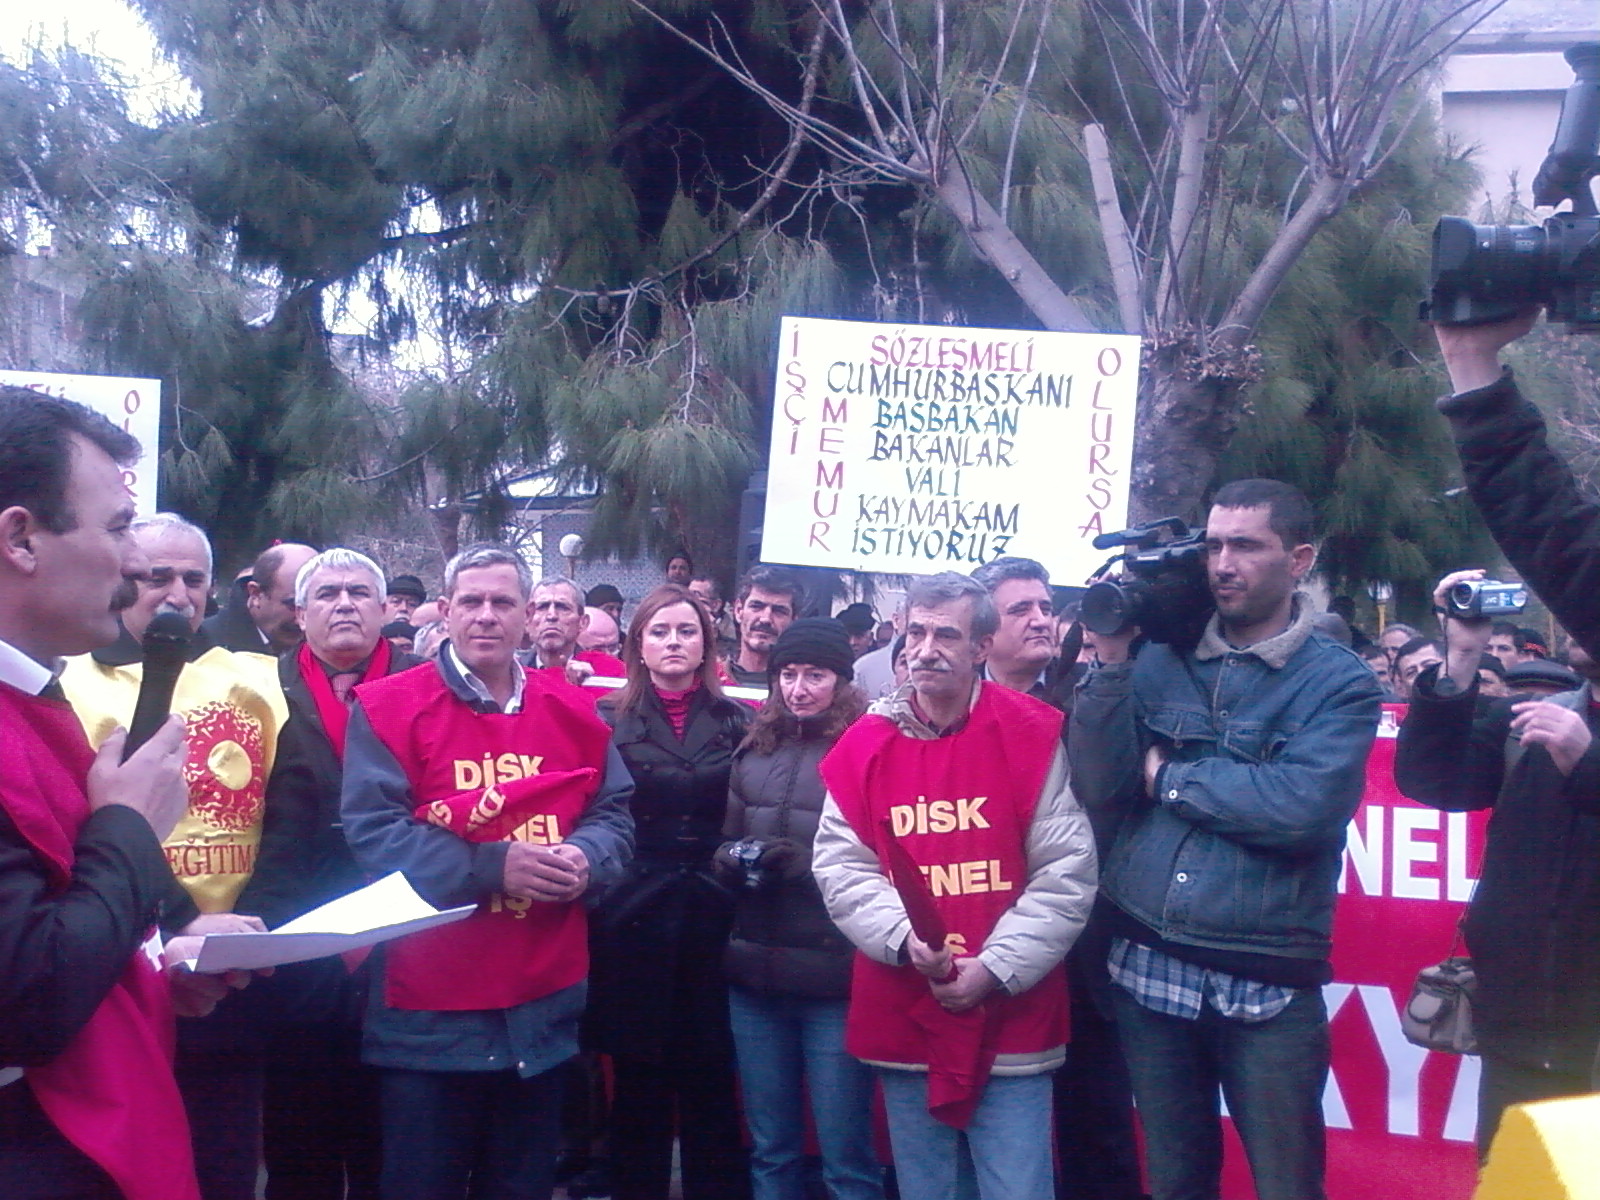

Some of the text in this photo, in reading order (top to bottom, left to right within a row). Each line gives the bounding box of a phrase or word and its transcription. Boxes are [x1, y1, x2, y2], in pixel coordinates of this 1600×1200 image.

[866, 430, 1018, 468] BAKANLAR
[809, 397, 847, 552] MEMUR
[856, 493, 1021, 534] KAYMAKAM
[453, 751, 545, 790] DİSK
[890, 795, 991, 838] DİSK
[1337, 804, 1480, 902] NEL
